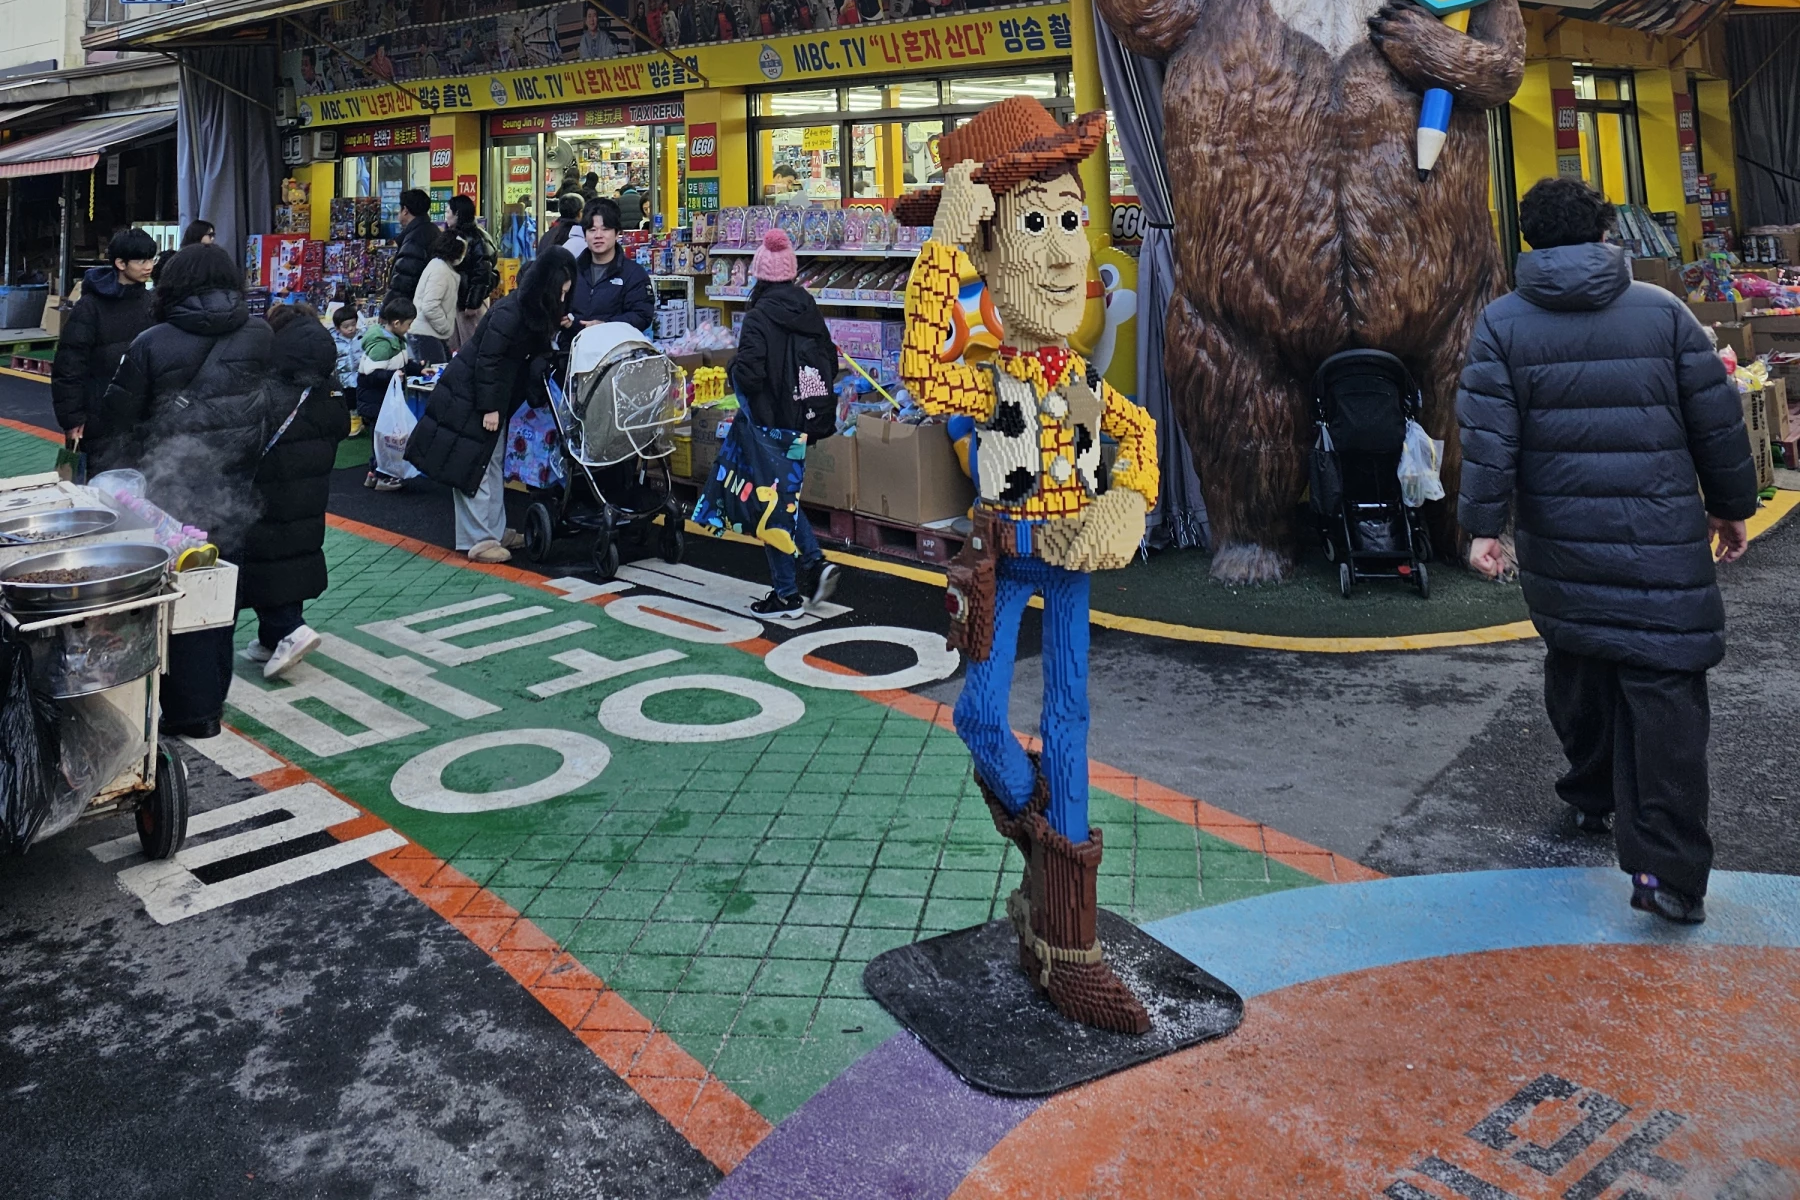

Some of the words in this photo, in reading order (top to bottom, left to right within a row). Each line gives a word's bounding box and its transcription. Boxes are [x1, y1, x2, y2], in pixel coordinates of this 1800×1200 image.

[902, 28, 942, 62] 혼자
[999, 16, 1045, 53] 방송
[586, 67, 613, 95] 혼자
[648, 59, 670, 88] 방송
[443, 83, 473, 108] 출연
[502, 118, 522, 130] Seung
[522, 117, 532, 127] Jin
[533, 116, 545, 128] Toy
[551, 112, 579, 128] 승진완구
[585, 108, 623, 125] 勝進玩具
[629, 106, 652, 122] TAX
[1558, 107, 1576, 131] LEGO
[1679, 111, 1693, 131] LEGO
[432, 149, 451, 167] LEGO
[691, 137, 715, 157] LEGO
[512, 165, 529, 175] LEGO
[459, 182, 476, 193] TAX
[1110, 205, 1147, 238] EGO
[716, 464, 753, 502] DINO
